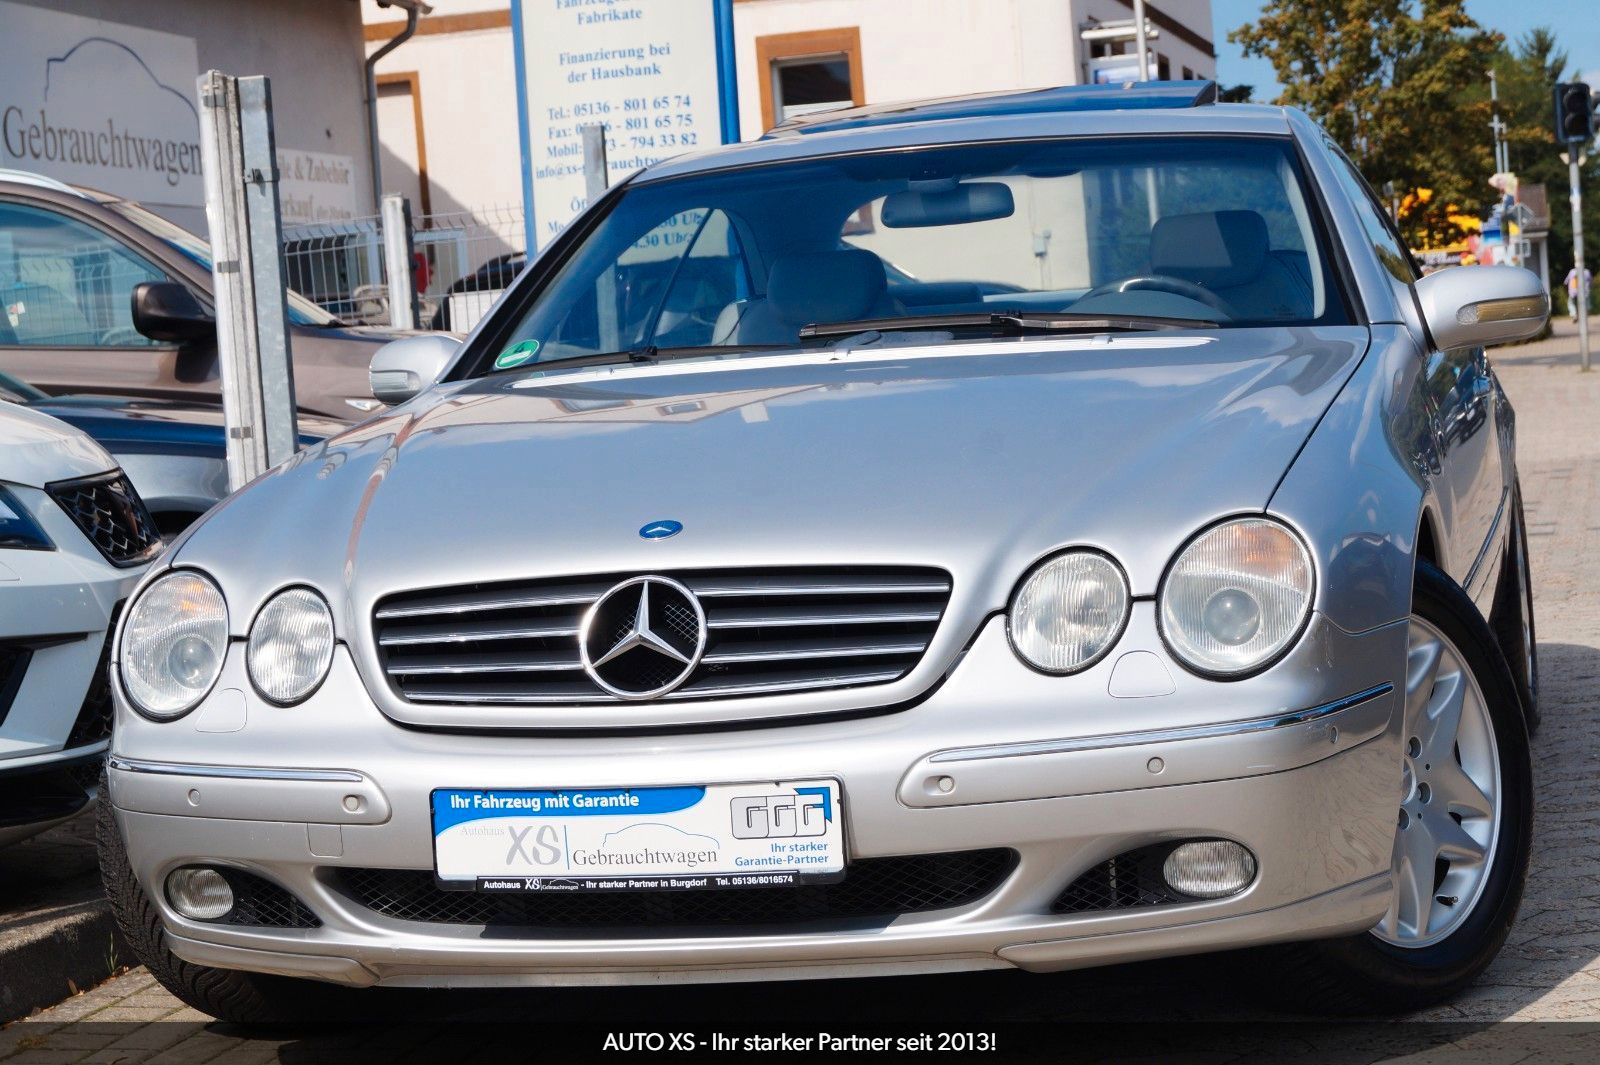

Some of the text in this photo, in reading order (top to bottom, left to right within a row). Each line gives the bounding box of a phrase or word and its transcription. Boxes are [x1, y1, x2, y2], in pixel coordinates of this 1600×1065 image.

[577, 8, 642, 25] Fabrikate
[559, 43, 671, 66] Finanzierung bei
[567, 63, 662, 84] der Hausbank
[574, 102, 610, 117] 05136
[624, 98, 647, 111] 801
[653, 96, 669, 109] 65
[674, 95, 691, 107] 74
[548, 126, 572, 140] Fax:
[625, 117, 648, 130] 801
[655, 116, 671, 128] 65
[676, 114, 693, 127] 75
[3, 106, 202, 186] Gebrauchtwagen
[547, 143, 582, 158] Mobil:
[630, 136, 655, 149] 794
[660, 135, 676, 147] 33
[681, 133, 698, 145] 82
[450, 793, 639, 812] Ihr Fahrzeug mit Garantie
[460, 824, 718, 867] Autohaus XS Gebrauchtwagen
[770, 842, 828, 853] Ihr starker
[734, 854, 829, 867] Garantie-Partner
[484, 880, 521, 889] Autohaus
[525, 878, 540, 890] XS
[586, 880, 596, 889] Ihr
[599, 880, 627, 888] starker
[629, 879, 658, 888] Partner
[660, 879, 669, 887] in
[670, 878, 707, 889] Burgdorf
[716, 877, 731, 886] Tel.
[732, 875, 793, 886] 05136/8016574
